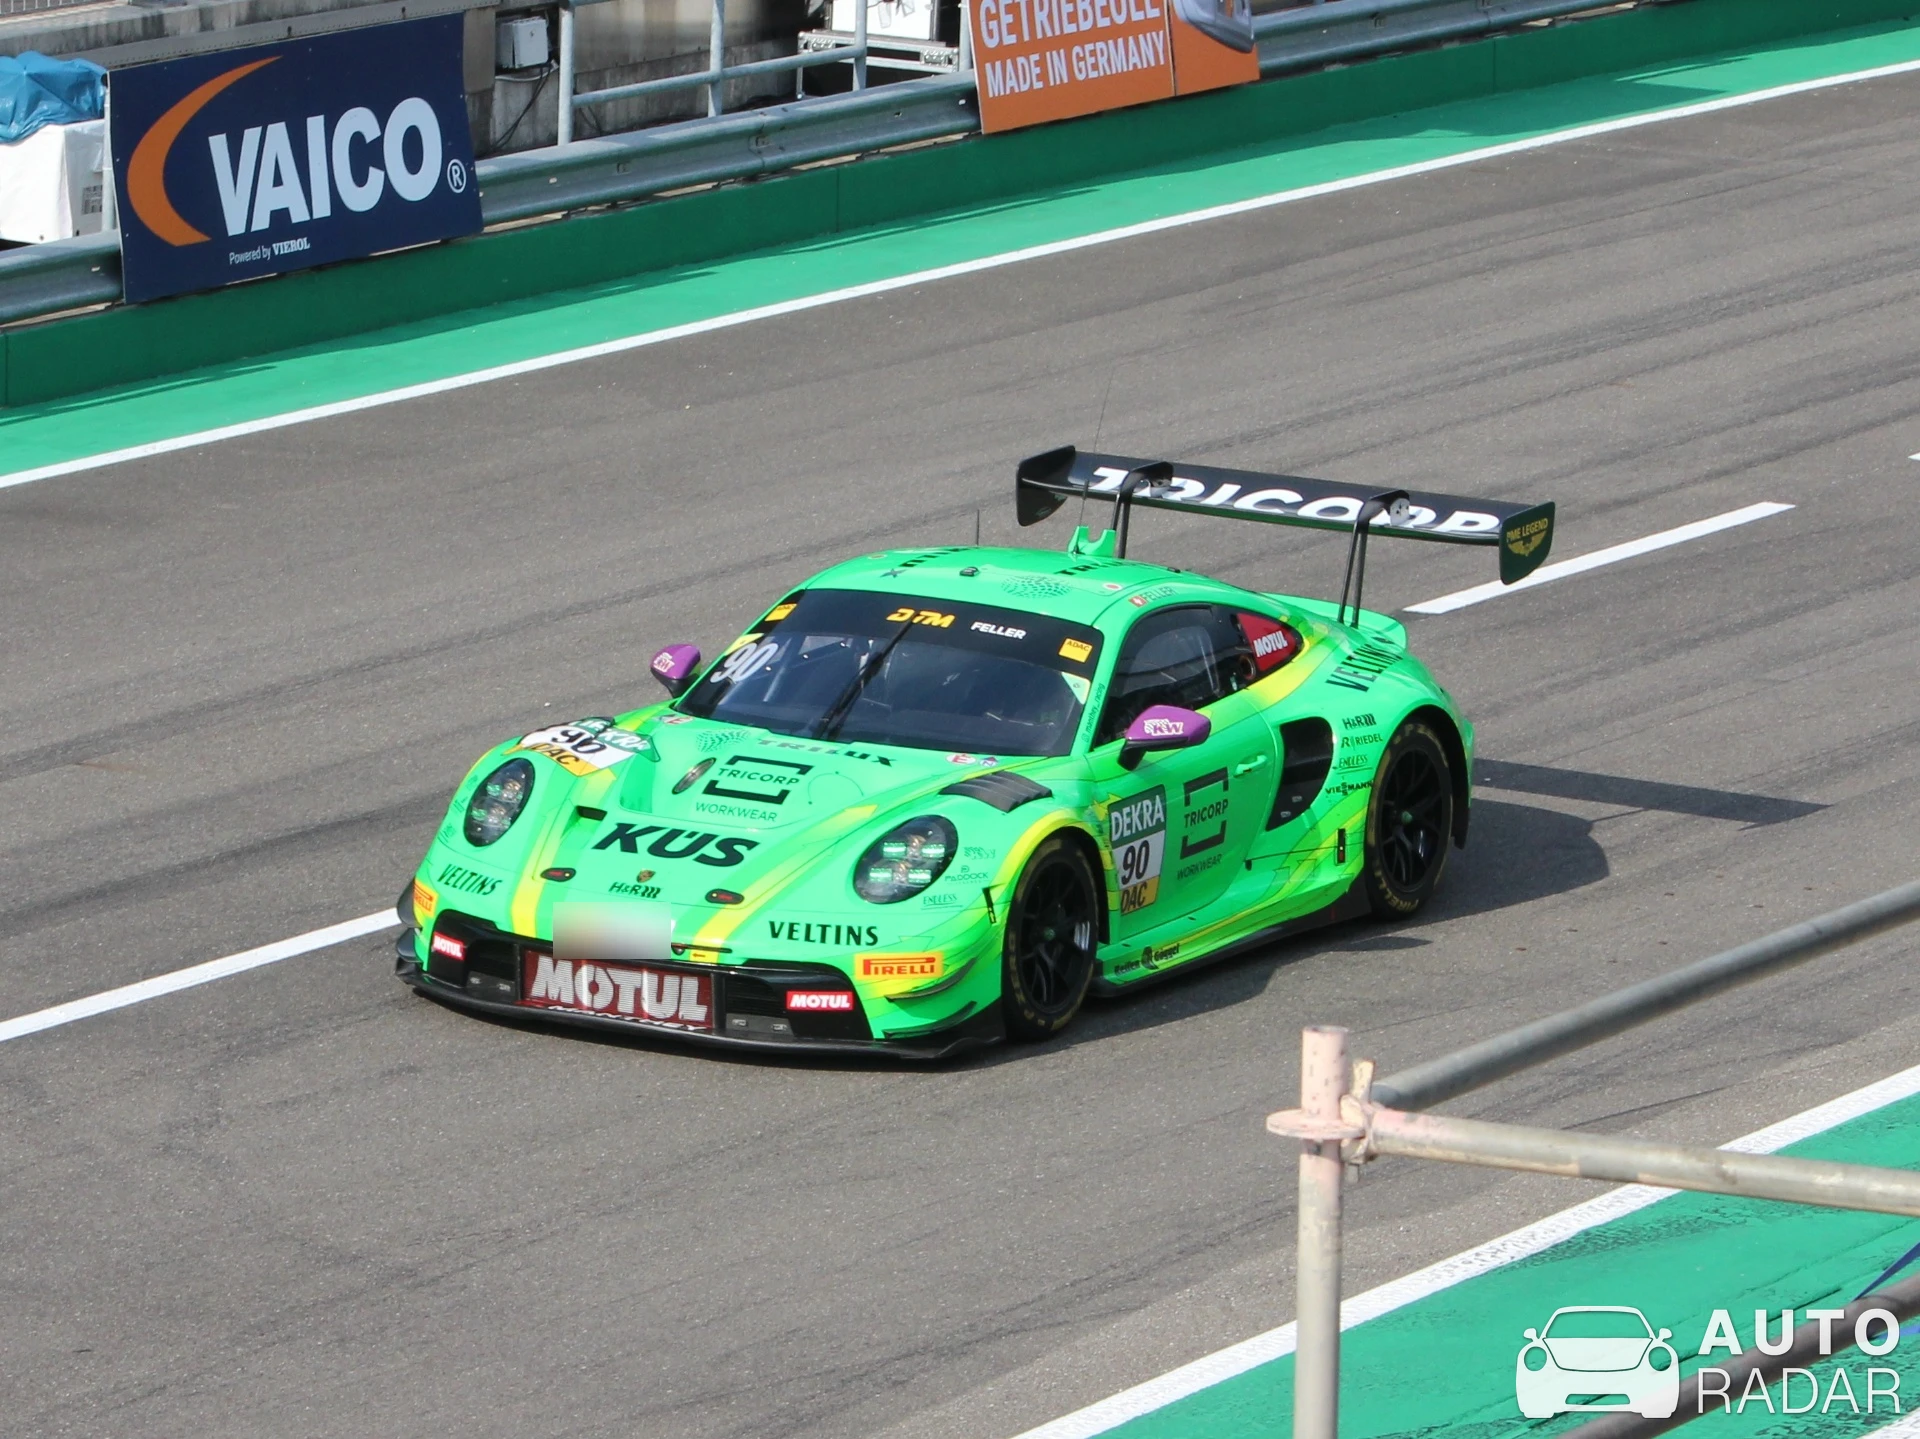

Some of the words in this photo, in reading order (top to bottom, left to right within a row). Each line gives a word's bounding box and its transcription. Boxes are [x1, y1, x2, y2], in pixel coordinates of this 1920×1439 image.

[985, 52, 1044, 98] MADE
[1048, 48, 1069, 86] IN
[1071, 30, 1166, 81] GERMANY
[229, 246, 261, 265] Powered
[261, 245, 271, 260] by
[272, 237, 311, 256] VIEROL
[1522, 518, 1549, 536] LEGEND
[886, 607, 955, 628] DTM
[970, 621, 1027, 640] FELLER
[1067, 640, 1090, 652] ADAC
[1253, 630, 1289, 657] MOTUL
[710, 642, 778, 684] 90
[552, 730, 608, 754] 90
[1355, 733, 1383, 747] RIEDEL
[718, 767, 800, 786] TRICORP
[695, 801, 777, 822] WORKWEAR
[1111, 795, 1164, 842] DEKRA
[1184, 799, 1228, 828] TRICORP
[592, 823, 760, 867] KÜS
[1121, 840, 1150, 885] 90
[1177, 854, 1222, 880] WORKWEAR
[437, 864, 503, 895] VELTINS
[433, 934, 463, 958] MOTUL
[769, 921, 878, 946] VELTINS
[863, 957, 936, 975] PIRELLI
[531, 955, 707, 1021] MOTUL
[790, 994, 851, 1008] MOTUL
